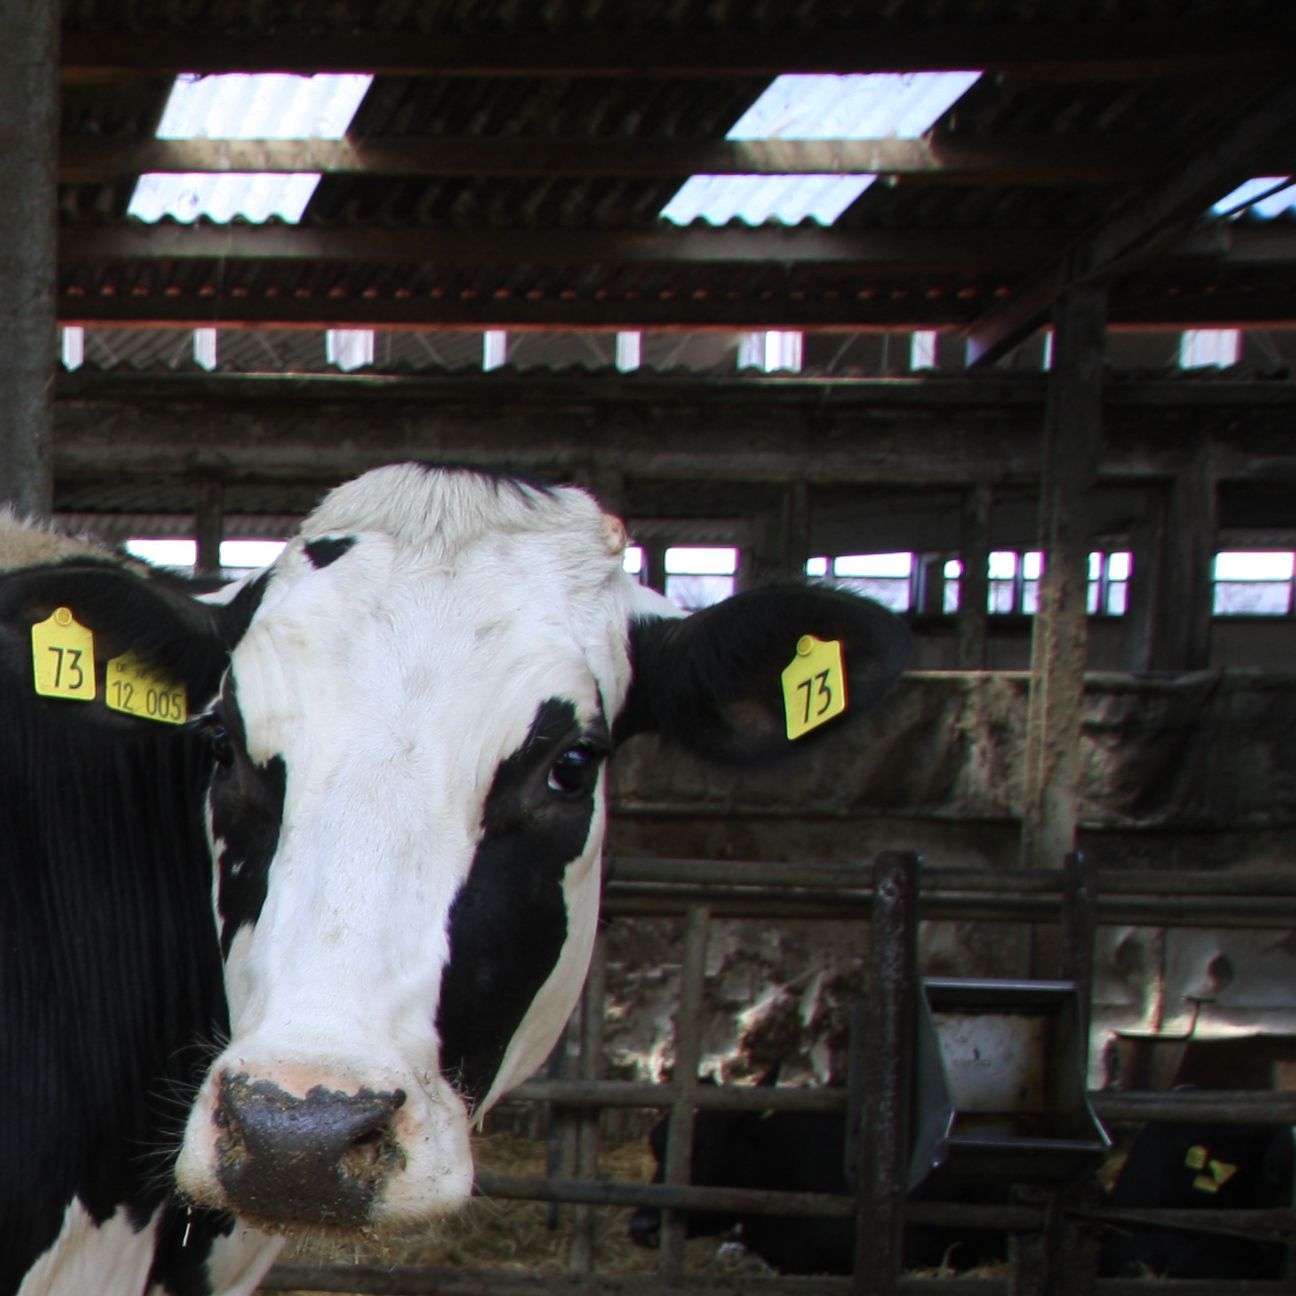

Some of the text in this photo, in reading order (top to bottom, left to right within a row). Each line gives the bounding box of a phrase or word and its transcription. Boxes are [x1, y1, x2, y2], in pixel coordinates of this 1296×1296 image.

[48, 646, 84, 690] 73
[112, 679, 183, 721] 12 005
[796, 667, 833, 725] 73
